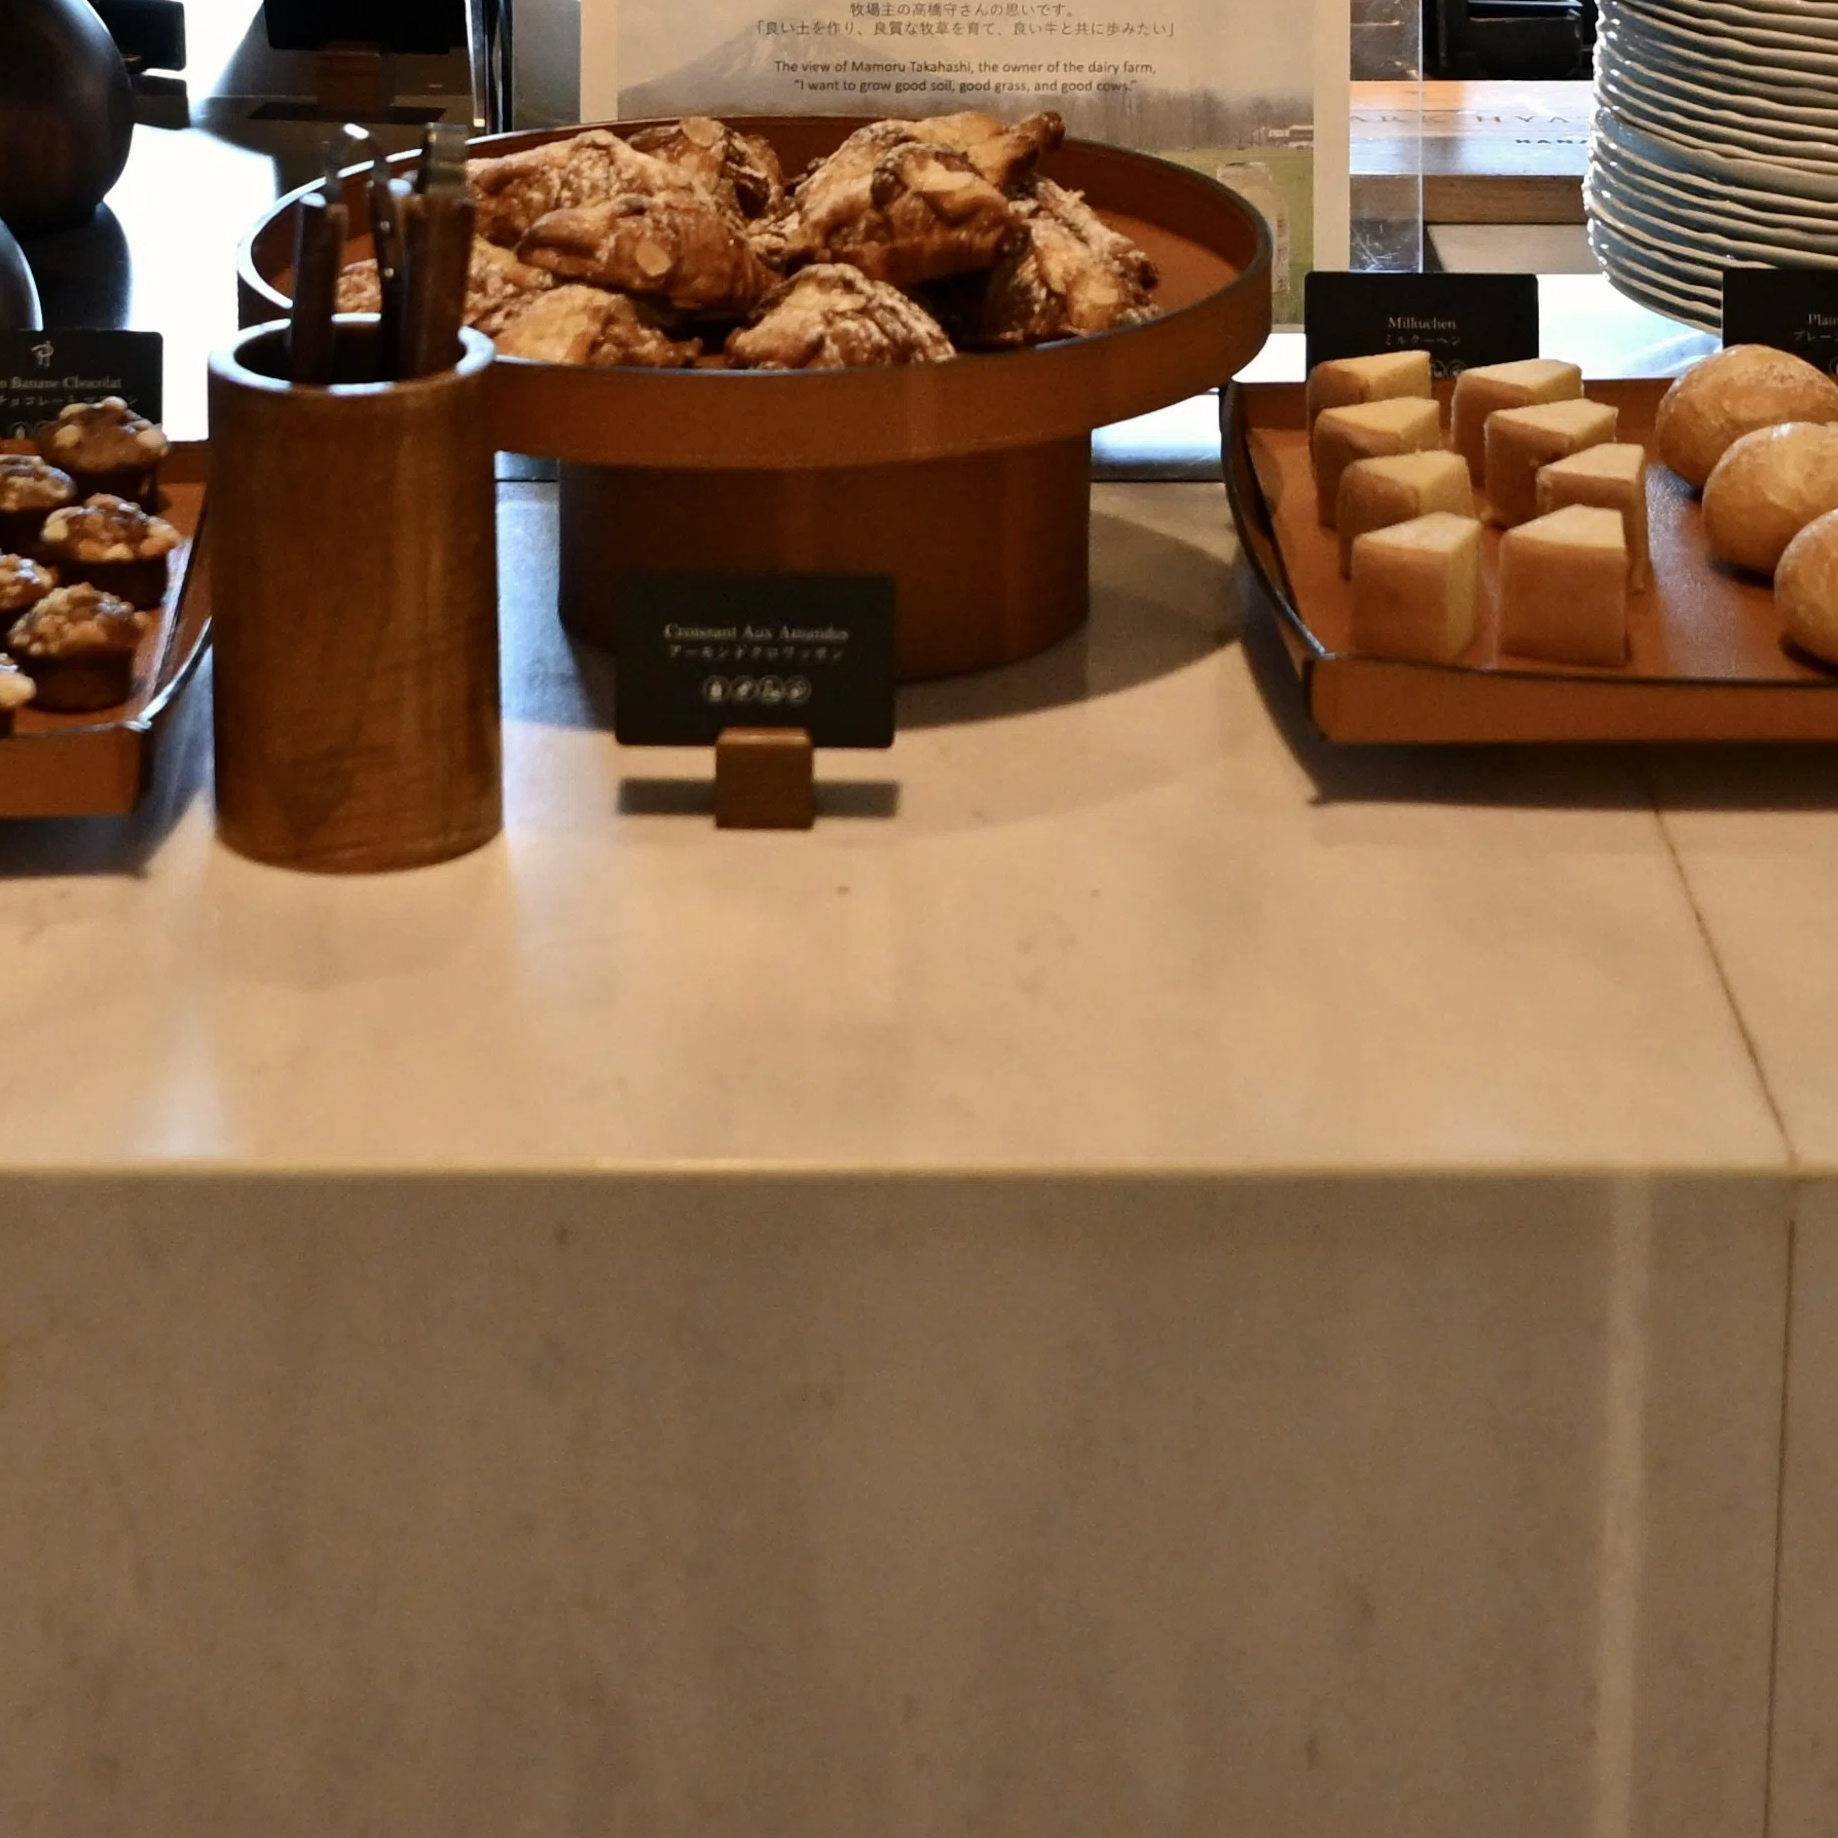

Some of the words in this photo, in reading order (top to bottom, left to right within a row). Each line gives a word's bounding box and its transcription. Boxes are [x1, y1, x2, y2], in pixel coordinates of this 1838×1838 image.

[774, 60, 798, 73] The
[801, 60, 830, 73] view
[834, 60, 848, 73] of
[851, 60, 906, 73] Mamoru
[909, 60, 974, 76] Takahashi,
[978, 60, 999, 73] the
[1002, 63, 1043, 73] owner
[1046, 60, 1061, 73] of
[1063, 60, 1085, 73] the
[1088, 60, 1119, 76] dairy
[1122, 60, 1157, 76] farm,
[808, 81, 839, 92] want
[843, 81, 856, 92] to
[859, 82, 892, 94] grow
[894, 79, 927, 94] good
[930, 79, 955, 93] soil,
[959, 79, 991, 94] good
[994, 81, 1030, 94] grass,
[1033, 79, 1058, 92] and
[1061, 79, 1093, 94] good
[1387, 315, 1457, 330] Milkuchen
[62, 375, 123, 390] Chocolat
[663, 622, 737, 640] Croissant
